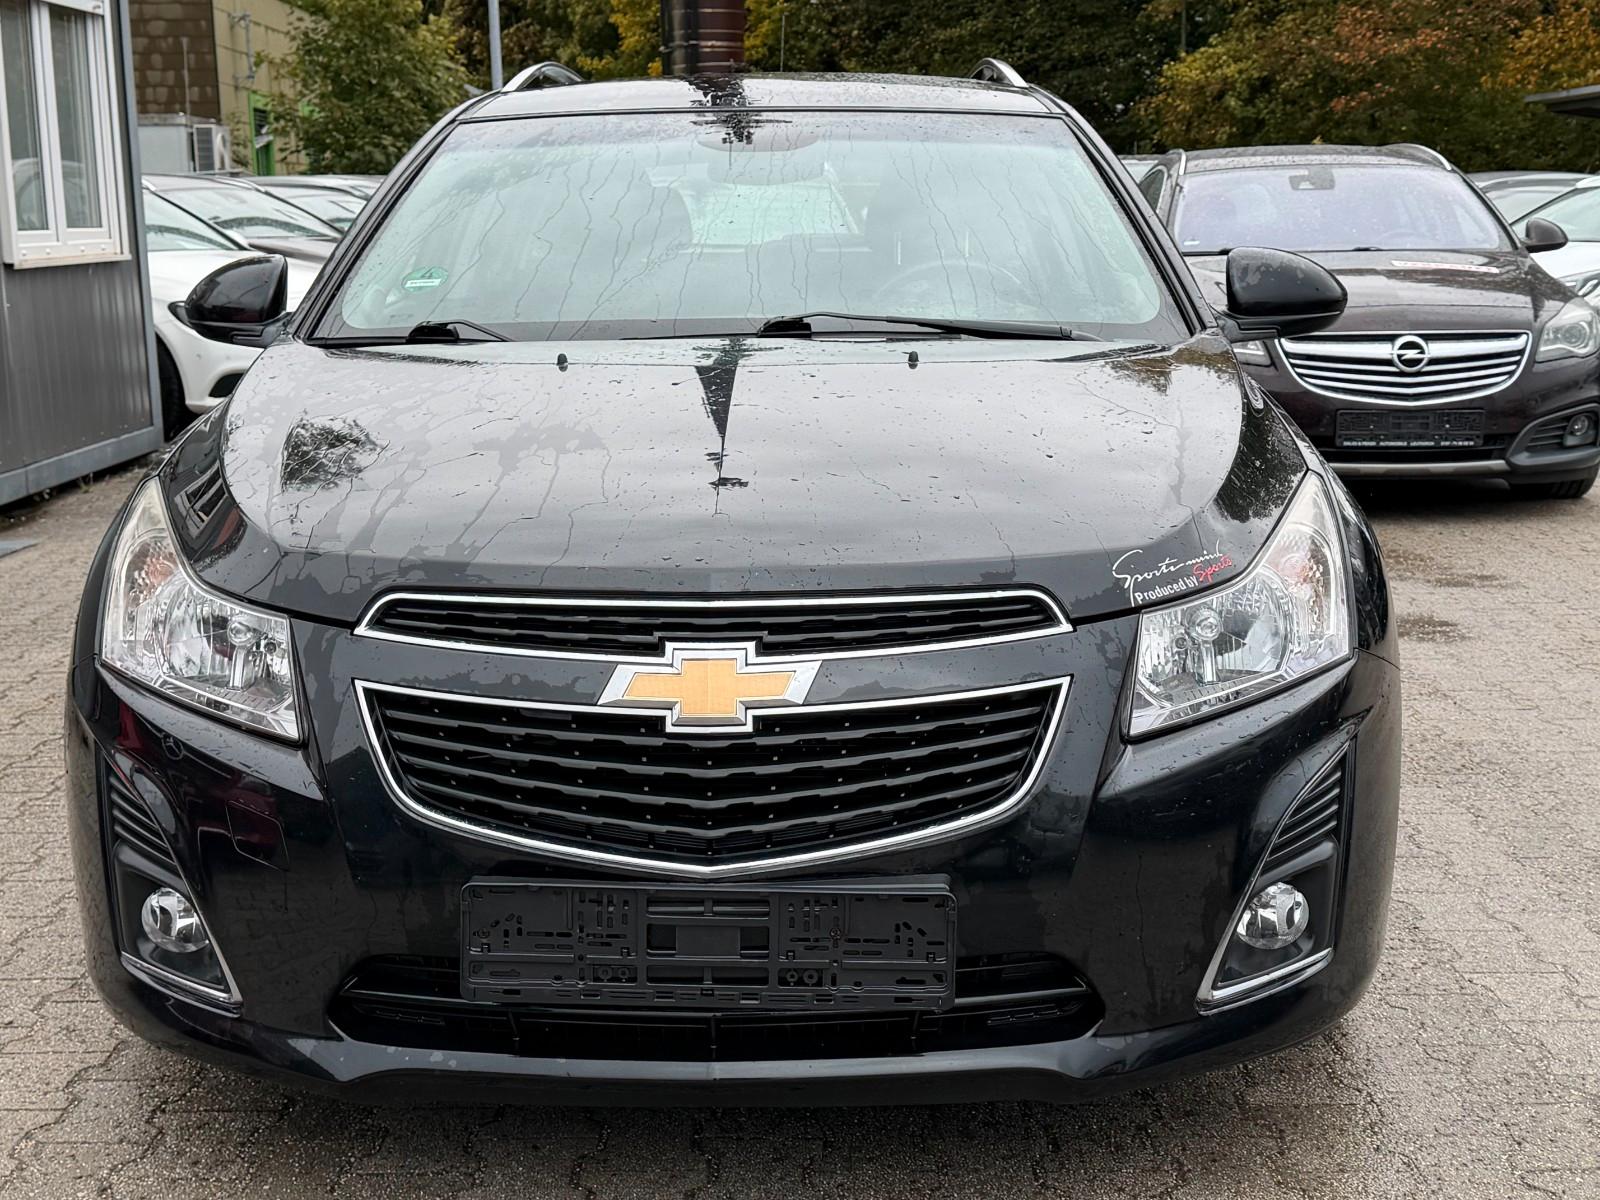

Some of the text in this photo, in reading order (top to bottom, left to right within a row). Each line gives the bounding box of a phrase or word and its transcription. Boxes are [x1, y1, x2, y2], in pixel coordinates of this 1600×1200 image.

[1135, 555, 1233, 604] Produced by Sports
